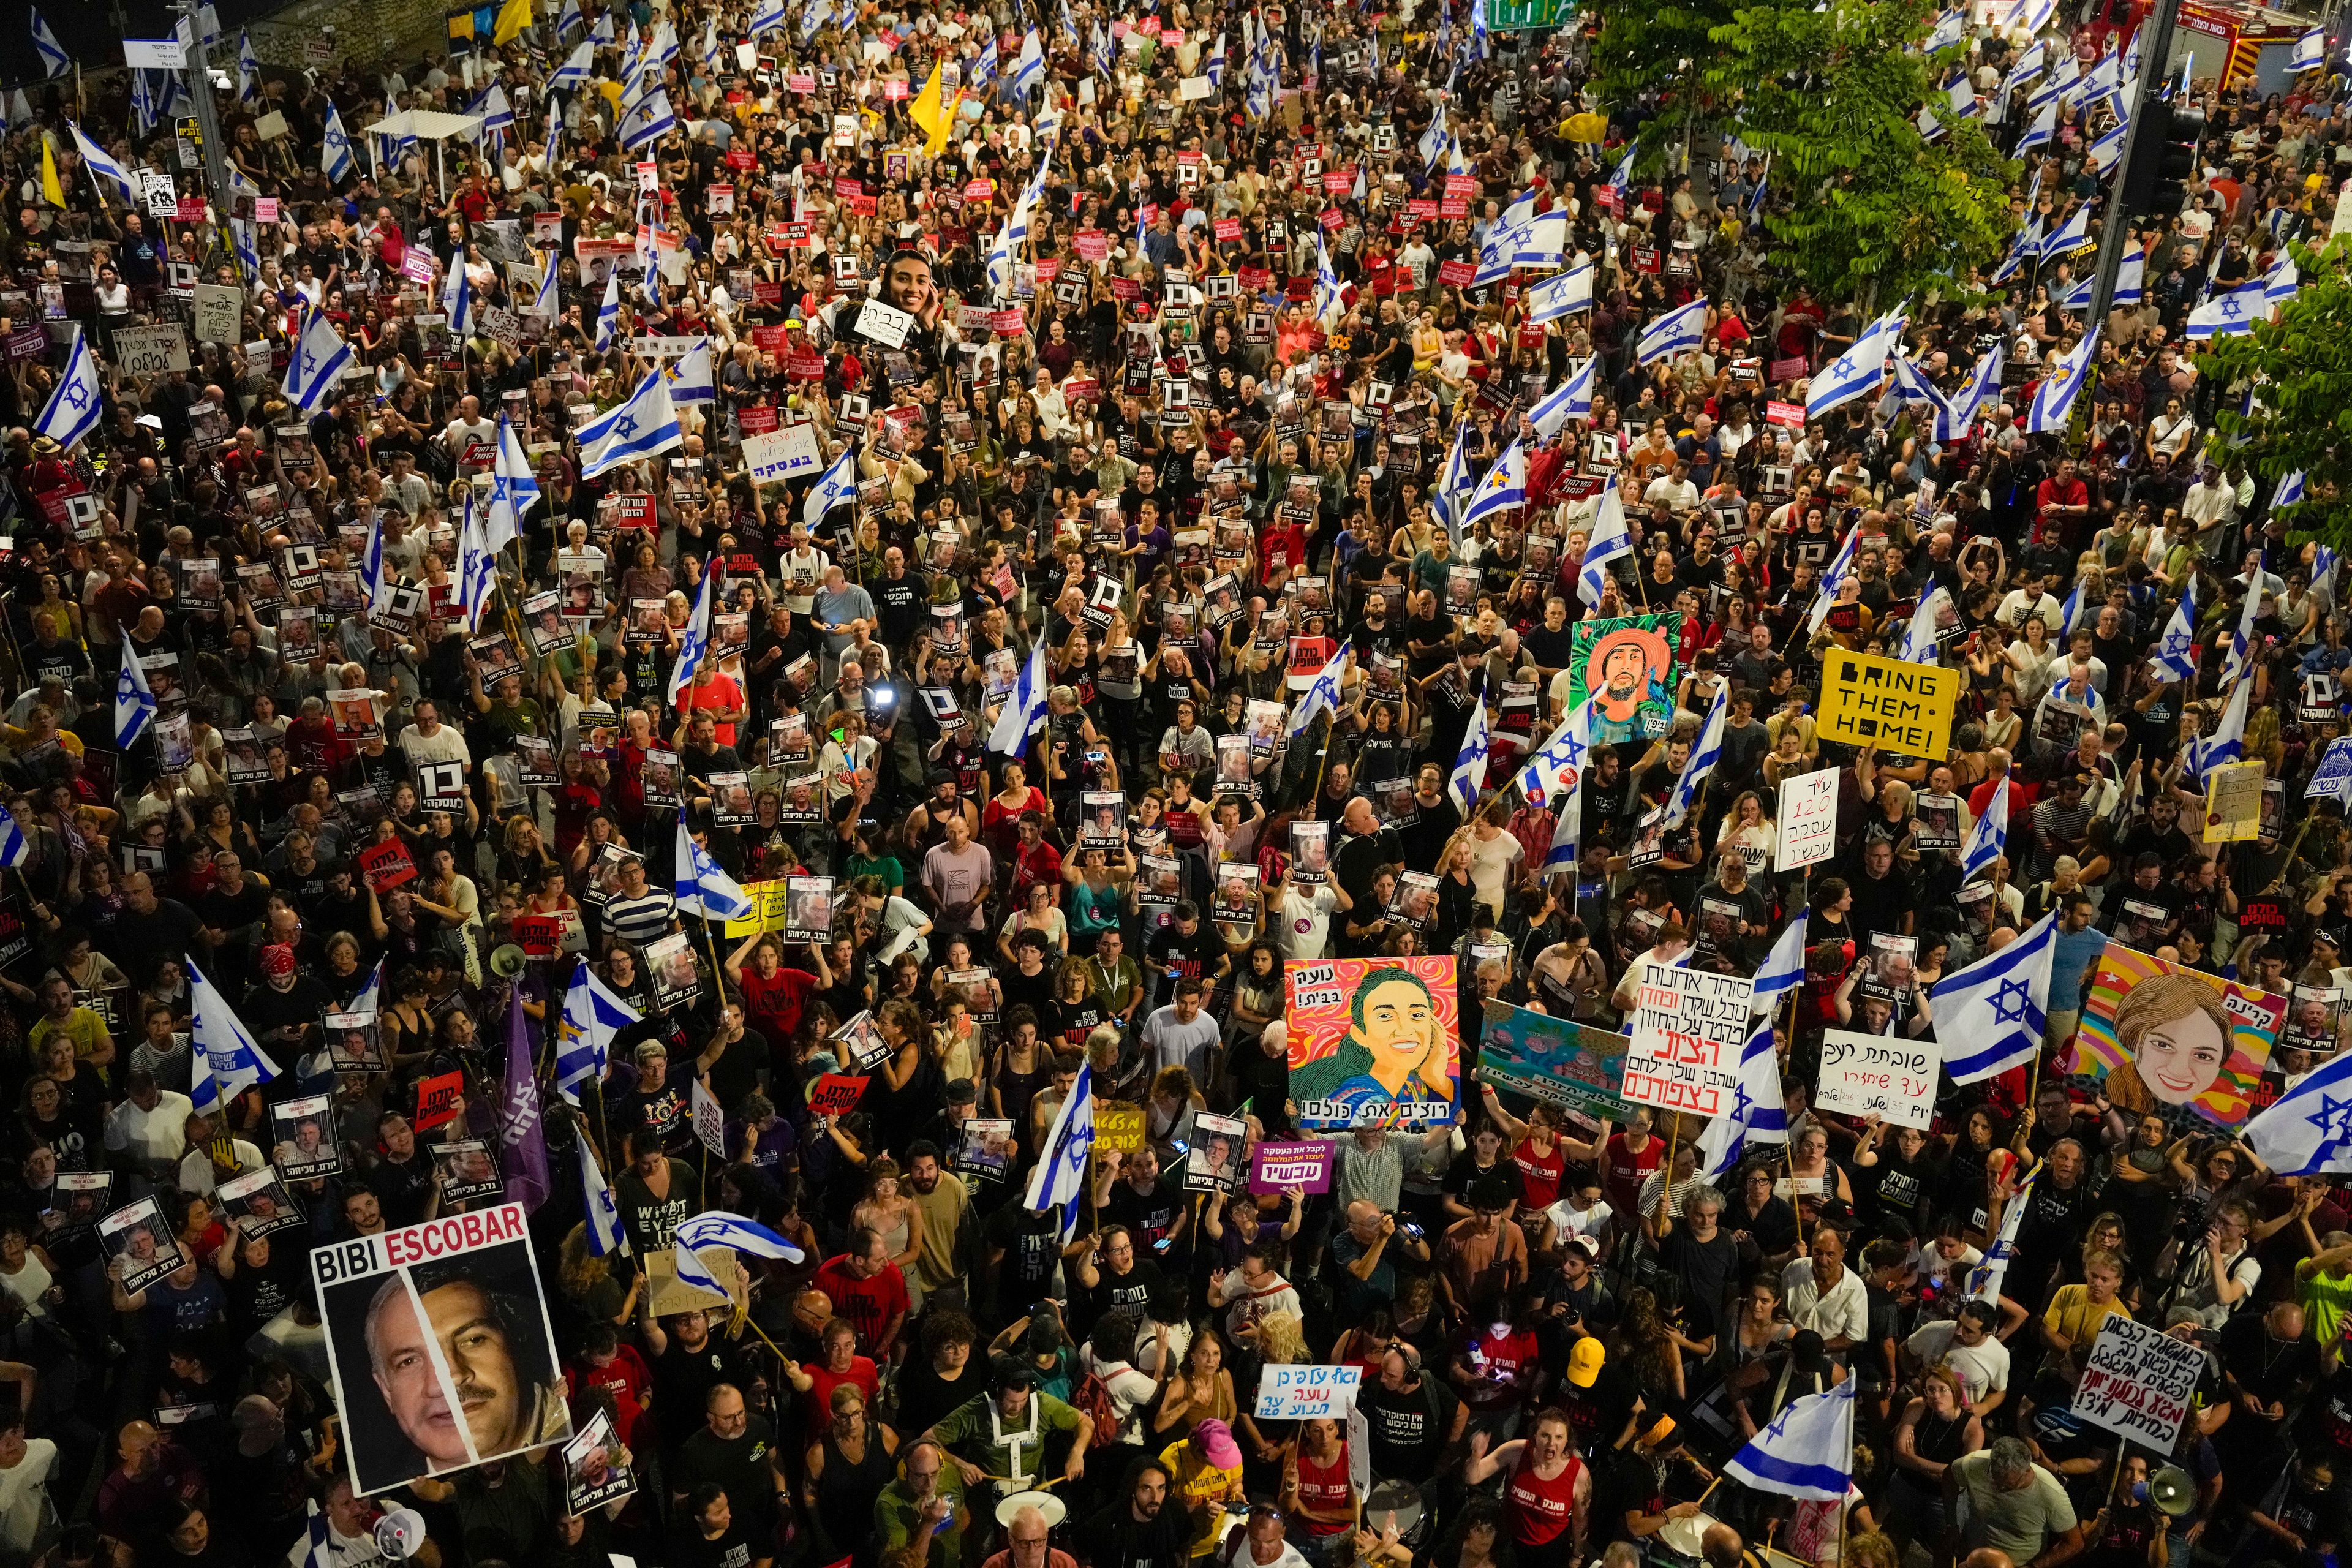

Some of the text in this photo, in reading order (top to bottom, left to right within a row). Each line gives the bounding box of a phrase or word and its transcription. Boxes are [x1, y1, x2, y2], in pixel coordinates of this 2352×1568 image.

[2192, 18, 2226, 35] כבאות והצלה
[1374, 136, 1391, 151] כן
[1305, 159, 1320, 176] כן
[168, 262, 194, 287] כן
[835, 255, 856, 278] כן
[1166, 285, 1189, 305] כן
[864, 306, 904, 333] בבית!
[1329, 334, 1351, 349] SOS
[1137, 361, 1147, 370] אל
[1131, 370, 1148, 379] תתנו
[1369, 382, 1392, 405] כן
[841, 393, 869, 421] כן
[1593, 434, 1618, 462] כן
[753, 454, 813, 478] בעסקה
[884, 592, 913, 601] חופשי
[1295, 647, 1317, 657] כולנו
[2307, 674, 2335, 702] כן
[1838, 688, 1921, 721] THEM
[2301, 707, 2336, 720] לעסקה!
[420, 763, 464, 797] כן
[423, 797, 464, 810] לעסקה!
[1793, 795, 1830, 818] 120
[1788, 820, 1831, 842] עסקה
[1791, 840, 1830, 862] עכשיו
[743, 883, 758, 891] STOP
[2247, 903, 2278, 914] כולנו
[2240, 913, 2285, 926] חטופים
[1297, 968, 1334, 985] נועה
[1642, 965, 1752, 1000] סוחר ארונות
[661, 985, 697, 1005] נדב, סליחה!
[1298, 991, 1341, 1007] בבית!
[1638, 986, 1677, 1009] ופחדן
[2226, 998, 2272, 1028] קרינה
[2286, 1036, 2312, 1046] סליחה!
[364, 1062, 382, 1071] יורם,
[826, 1084, 858, 1099] כולנו
[1485, 1067, 1583, 1106] עסקה עכשיו!
[1817, 1088, 1839, 1101] שלהם
[813, 1093, 858, 1107] חטופים
[1587, 1093, 1605, 1103] לא
[1302, 1099, 1448, 1119] רוצים את כולם!
[1611, 1102, 1629, 1111] הם
[1890, 1100, 1904, 1113] 35
[1910, 1105, 1929, 1119] יום
[1306, 1144, 1326, 1153] לקבל
[287, 1161, 337, 1176] יורם, סליחה!
[981, 1165, 1001, 1177] עמירם,
[1265, 1166, 1318, 1180] עכשיו
[251, 1215, 300, 1237] יורם, סליחה!
[315, 1205, 525, 1284] BIBI ESCOBAR
[658, 1231, 671, 1243] IT
[127, 1256, 179, 1289] יורם, סליחה!
[2098, 1316, 2147, 1343] הזאת
[2090, 1344, 2142, 1379] מתגלגל
[1277, 1366, 1357, 1387] ואף על פי כן
[1264, 1396, 1285, 1408] עד
[1294, 1389, 1330, 1401] נועה
[2080, 1368, 2185, 1424] מגיע לכולנו יותר
[1259, 1408, 1280, 1416] 120
[1288, 1403, 1330, 1416] תנוע
[1387, 1419, 1409, 1428] כיבוש
[2112, 1409, 2174, 1443] בחירות
